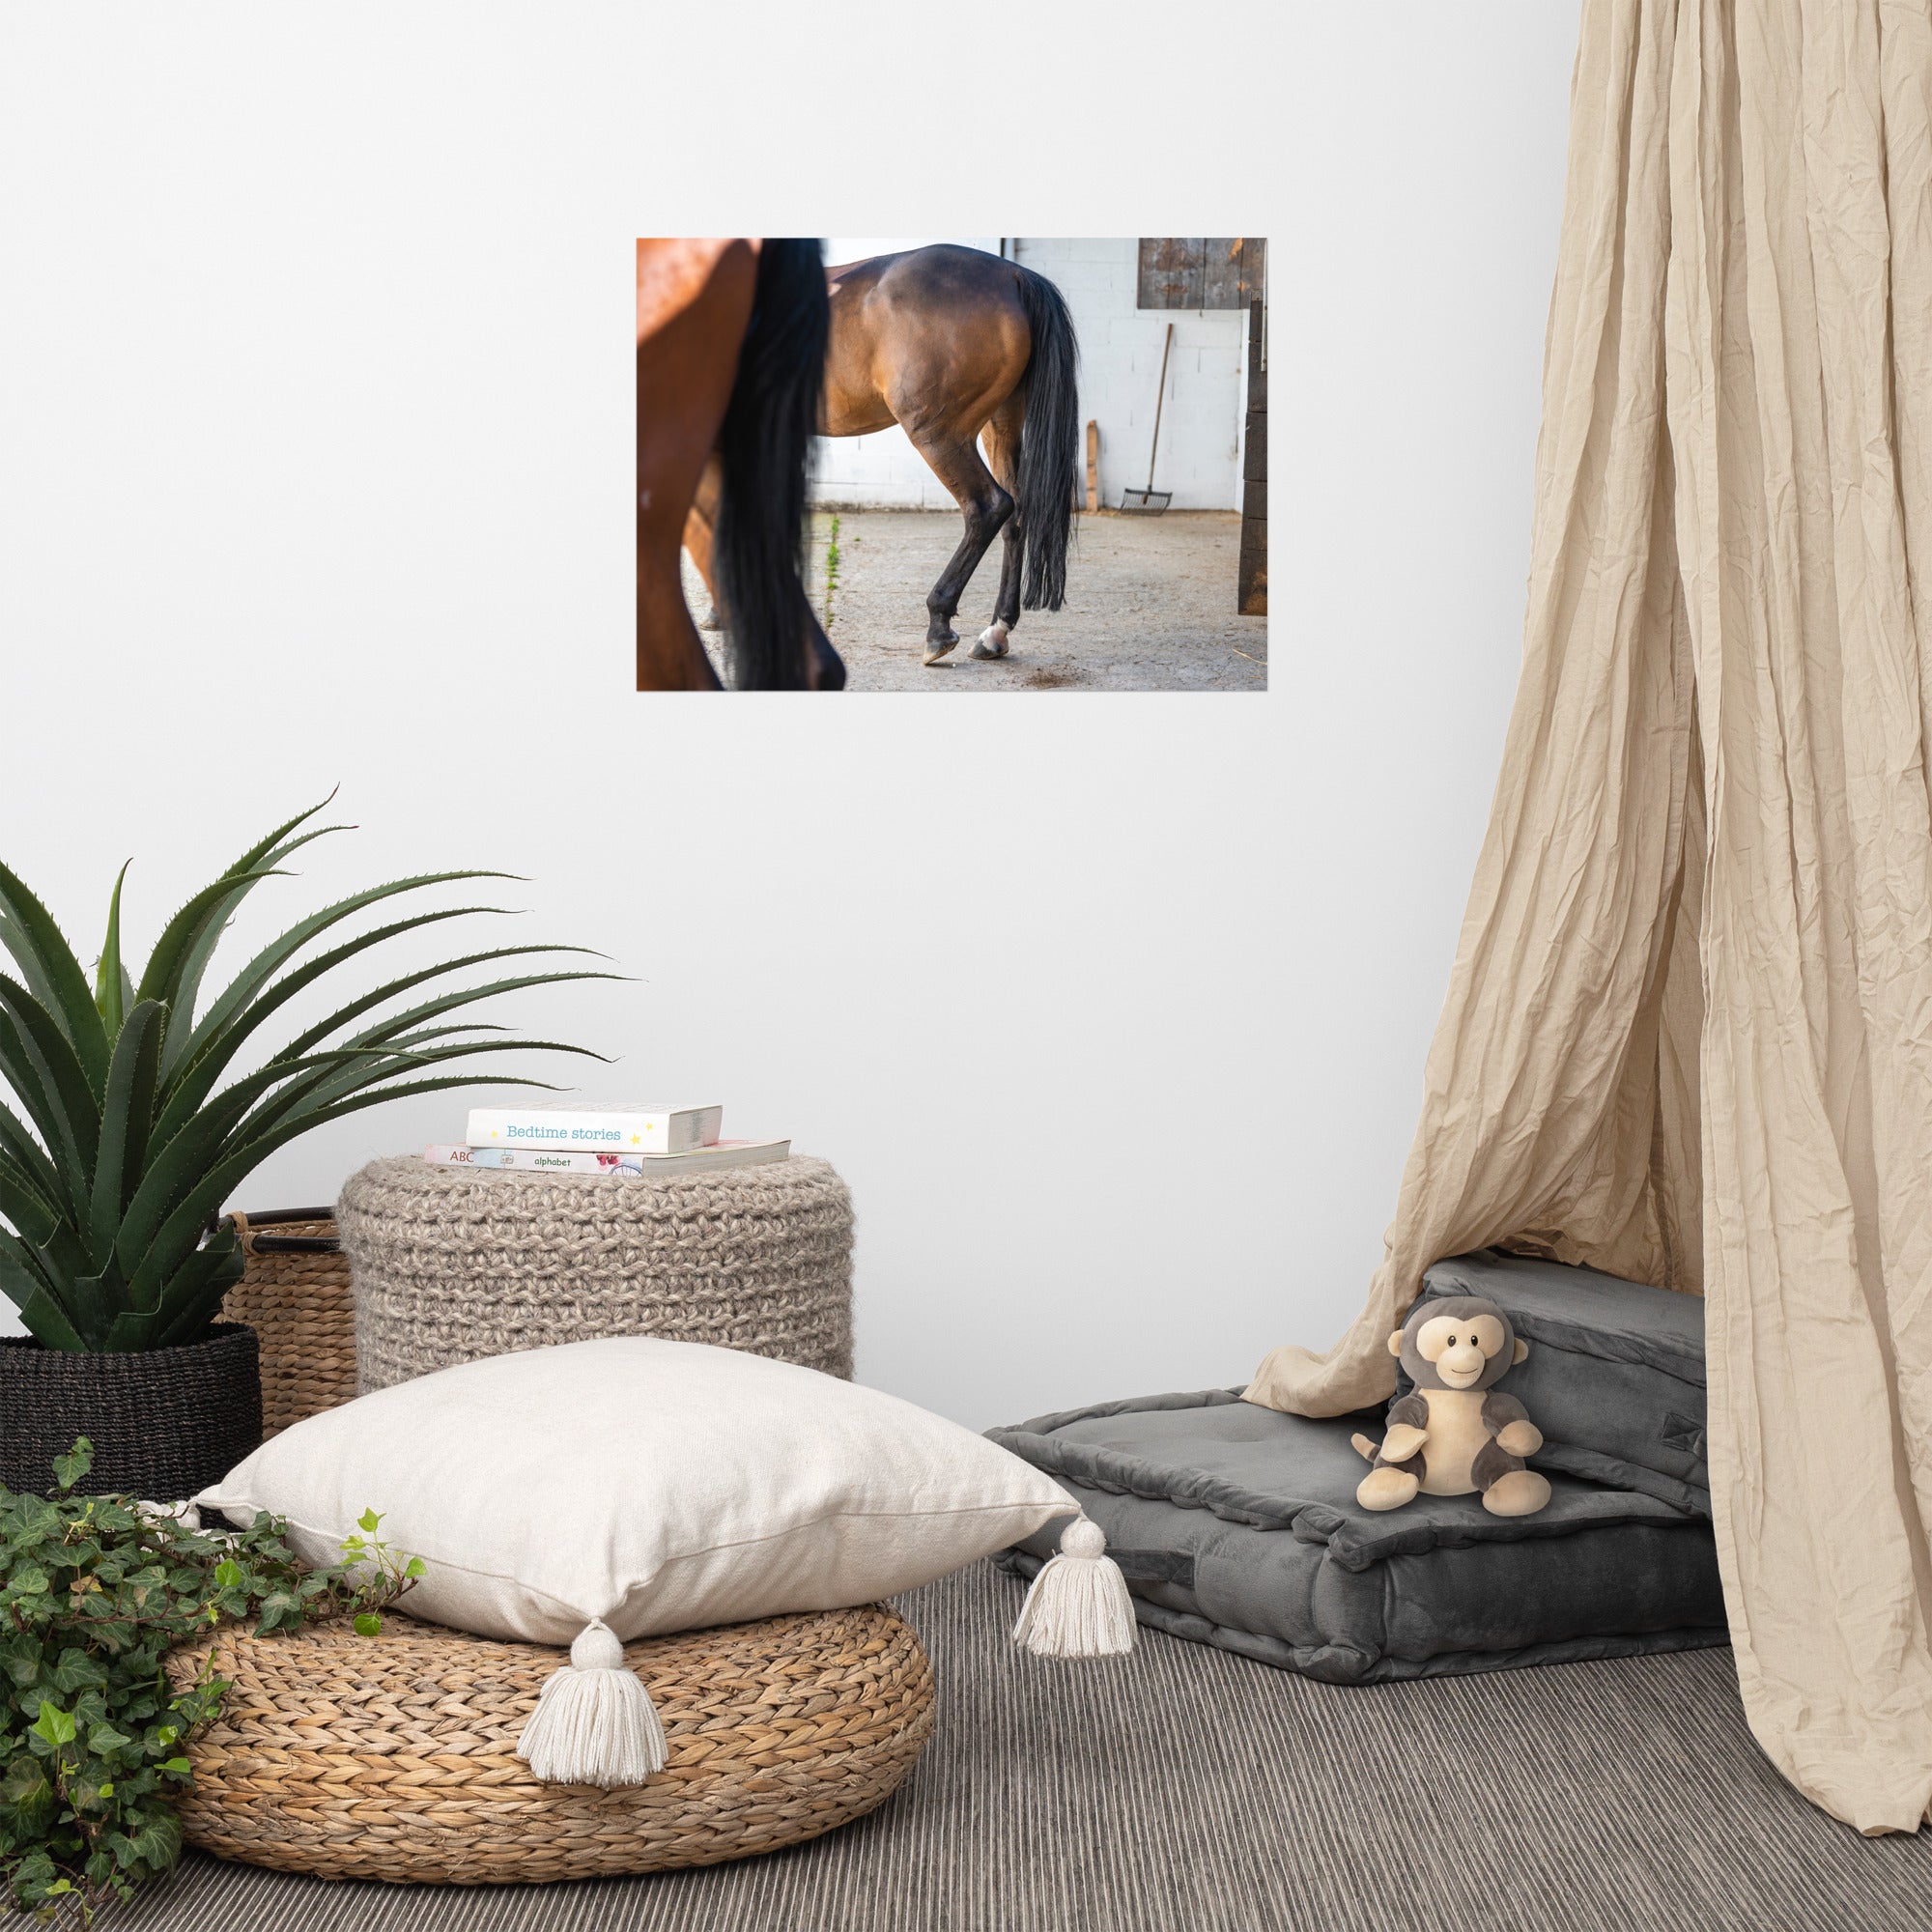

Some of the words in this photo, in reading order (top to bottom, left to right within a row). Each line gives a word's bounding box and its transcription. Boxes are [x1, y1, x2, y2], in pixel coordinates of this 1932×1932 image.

[506, 1125, 567, 1139] Bedtime
[571, 1128, 621, 1140] stories
[449, 1151, 474, 1162] ABC
[534, 1156, 571, 1167] alphabet
